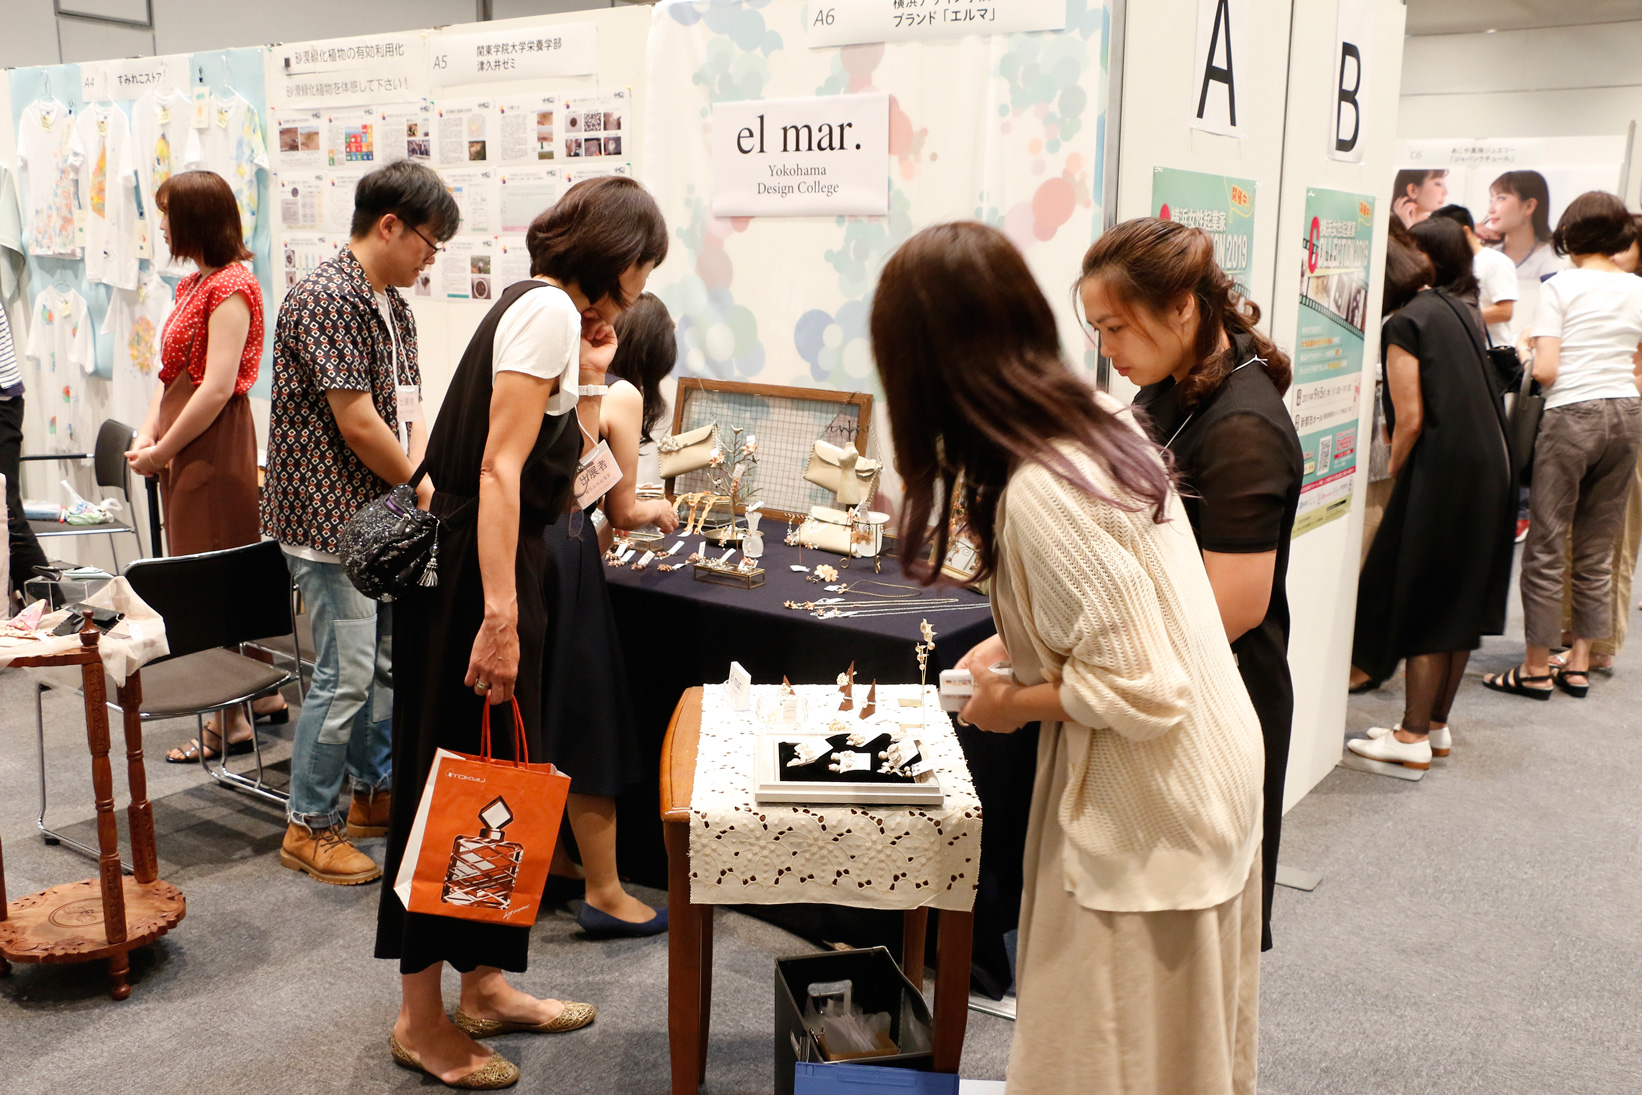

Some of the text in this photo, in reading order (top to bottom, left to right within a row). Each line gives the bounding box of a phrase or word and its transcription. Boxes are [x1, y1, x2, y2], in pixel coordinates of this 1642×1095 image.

[813, 8, 835, 27] A6
[892, 7, 996, 28] ブランド「エルマ」
[294, 42, 405, 65] 砂漠緑化植物の有効利用化
[476, 37, 562, 57] 関東学院大学栄養学部
[433, 55, 448, 70] A5
[477, 58, 516, 72] 津久井ゼミ
[1196, 0, 1237, 127] A
[84, 77, 95, 88] A4
[1335, 41, 1361, 152] B
[736, 114, 862, 155] el mar.
[768, 163, 827, 177] Yokohama
[757, 180, 840, 198] Design College
[1225, 234, 1248, 270] 2019
[579, 459, 608, 487] 出展者
[452, 773, 486, 783] TOKYU
